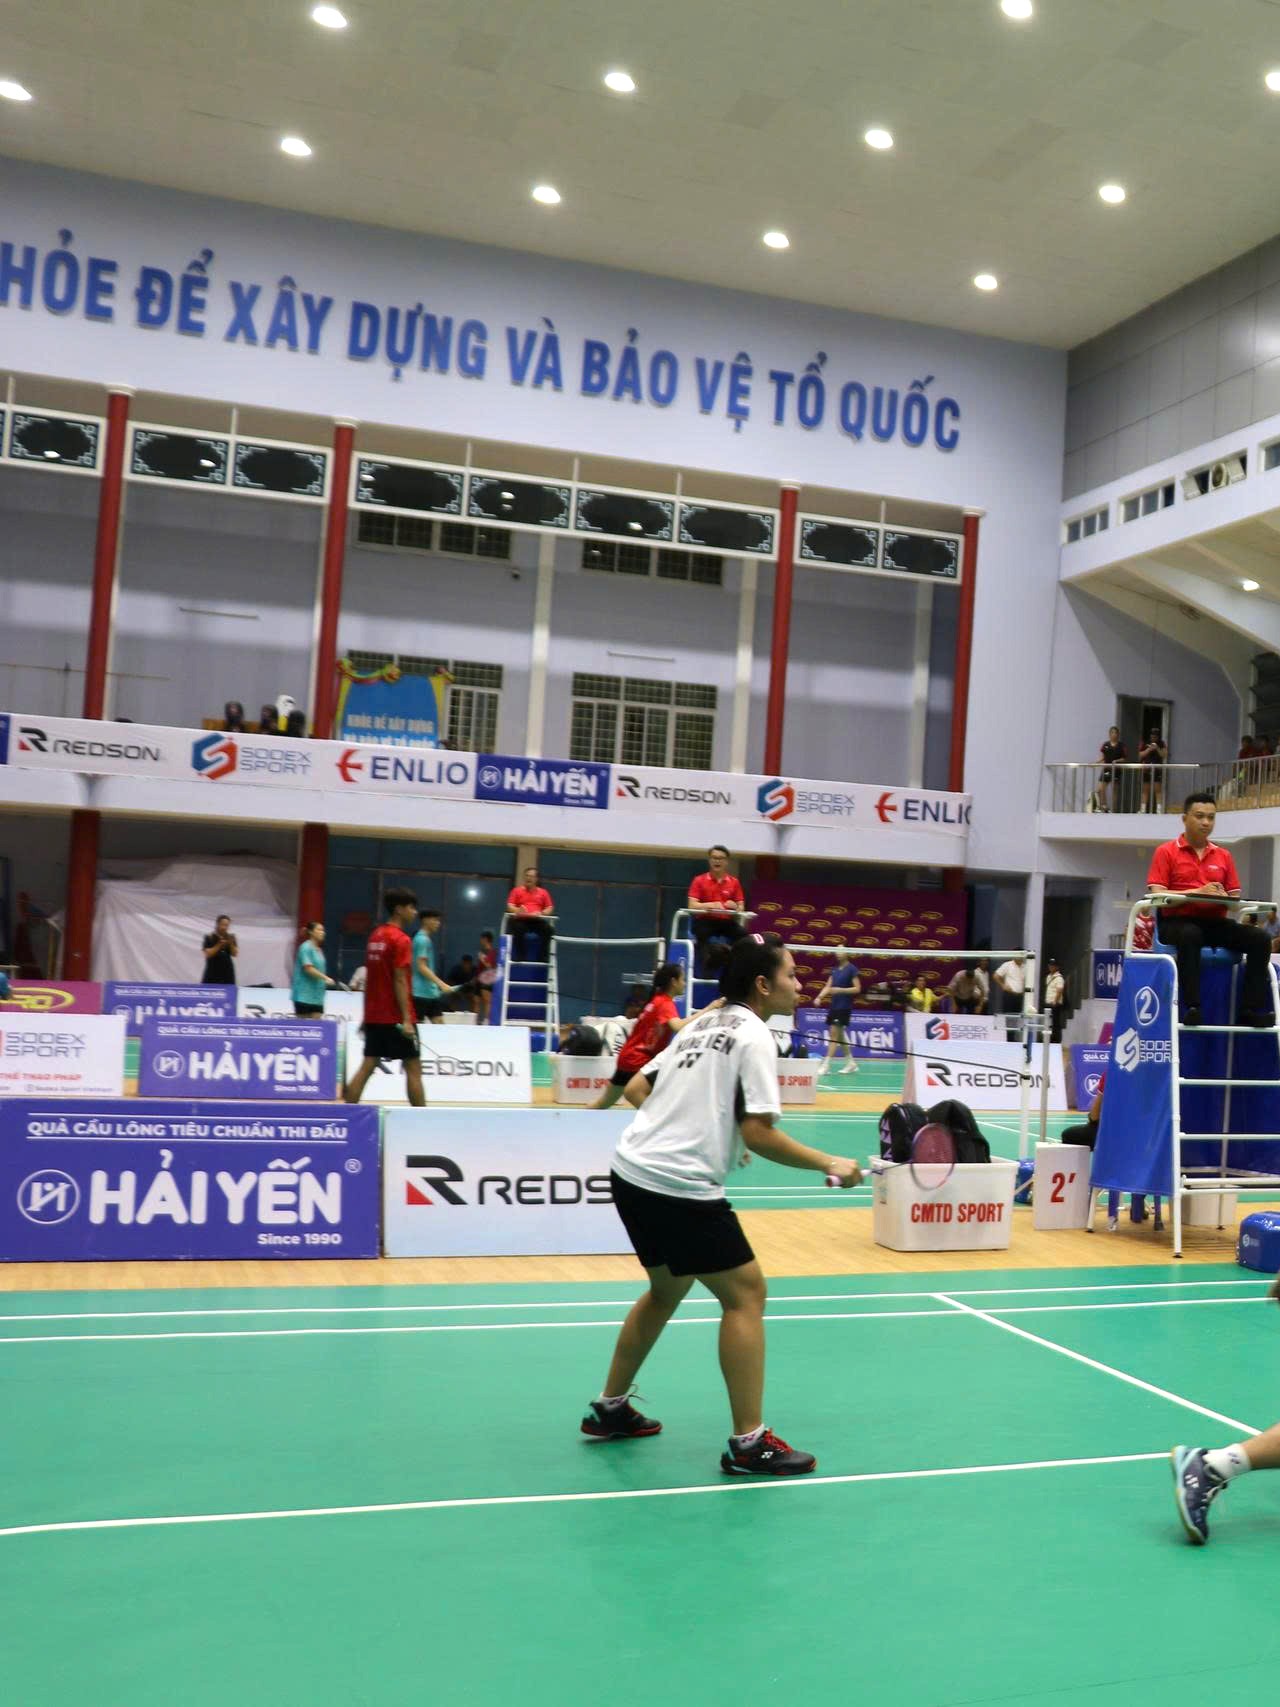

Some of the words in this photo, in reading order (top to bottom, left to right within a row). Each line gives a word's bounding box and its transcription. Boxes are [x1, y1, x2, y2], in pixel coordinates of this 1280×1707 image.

[136, 248, 214, 337] ĐỂ
[224, 275, 334, 355] XÂY
[347, 300, 490, 382] DỰNG
[506, 317, 563, 392] VÀ
[580, 327, 679, 409] BẢO
[695, 351, 753, 432] VỆ
[769, 351, 828, 431] TỔ
[838, 374, 962, 453] QUỐC
[53, 740, 160, 762] REDSON
[241, 747, 311, 763] SODEX
[241, 760, 311, 775] SPORT
[371, 756, 469, 785] ENLIO
[503, 760, 547, 793] HẢI
[550, 768, 598, 797] YẾN
[645, 786, 731, 804] REDSON
[796, 791, 855, 805] SODEX
[796, 803, 855, 816] SPORT
[1107, 956, 1123, 986] HẢ
[1139, 989, 1152, 1020] 2
[6, 1032, 86, 1045] SODEX
[1140, 1040, 1172, 1050] SODE
[5, 1046, 86, 1058] SPORT
[1139, 1052, 1172, 1063] SPOR
[189, 1041, 249, 1080] HẢI
[253, 1047, 320, 1082] YẾN
[400, 1060, 513, 1077] EDSON
[788, 1076, 812, 1087] SPORT
[28, 1118, 70, 1136] QUẢ
[73, 1117, 113, 1136] CẦU
[116, 1119, 165, 1137] LÔNG
[169, 1119, 210, 1137] TIÊU
[278, 1126, 306, 1139] THI
[310, 1120, 348, 1140] ĐẤU
[89, 1148, 208, 1225] HẢI
[215, 1156, 341, 1225] YẾN
[478, 1175, 612, 1205] REDS
[911, 1203, 952, 1223] CMTD
[957, 1203, 1004, 1223] SPORT
[258, 1233, 300, 1246] Since
[304, 1233, 342, 1246] 1990
